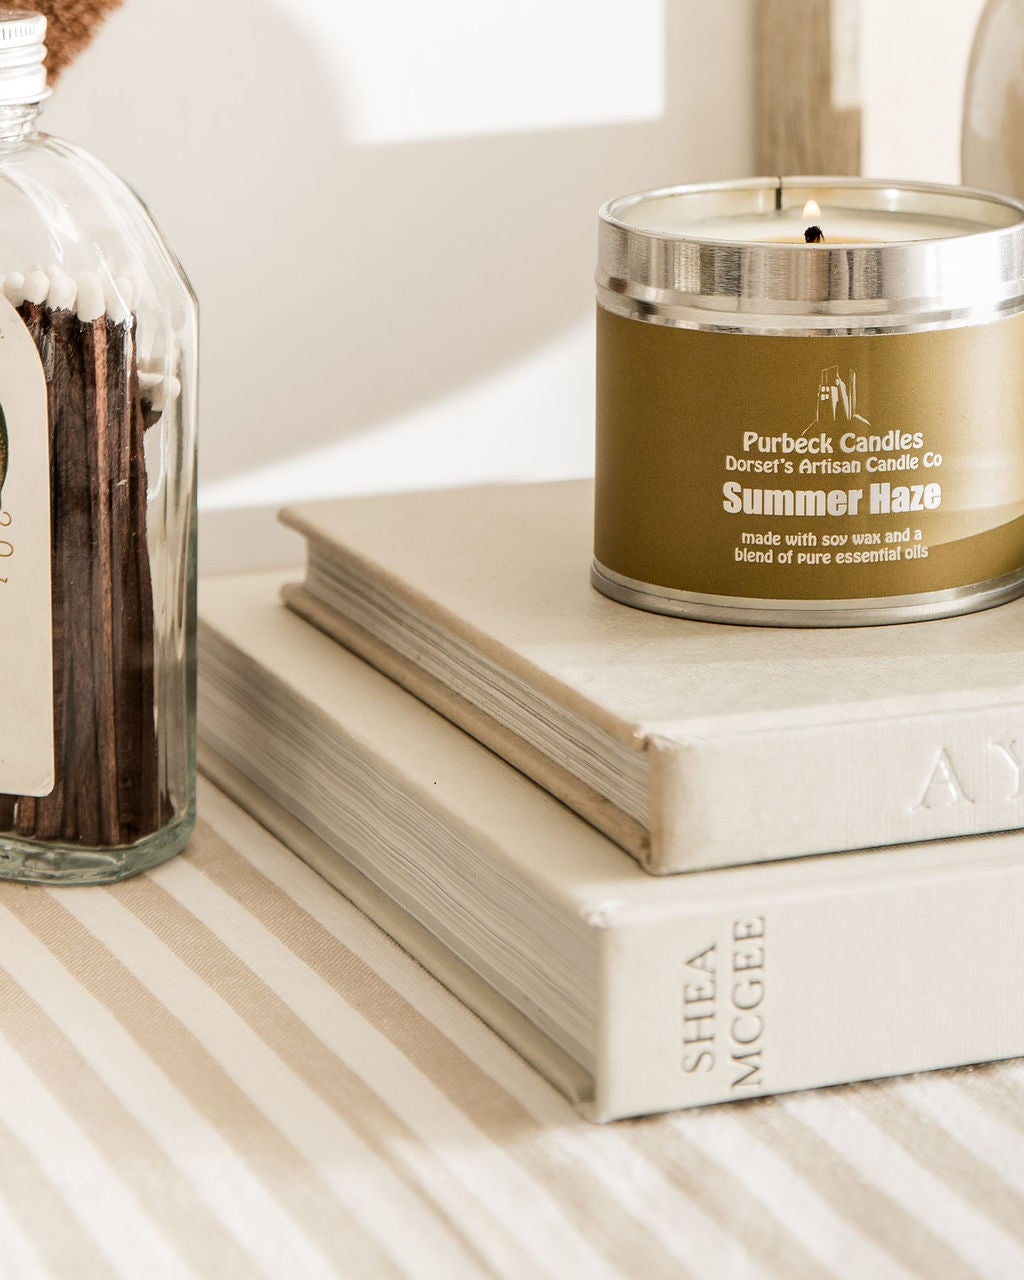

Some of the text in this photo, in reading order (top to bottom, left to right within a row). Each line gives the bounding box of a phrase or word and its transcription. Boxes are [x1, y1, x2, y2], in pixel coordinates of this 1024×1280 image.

[743, 429, 924, 454] Purbeck Candles
[725, 451, 943, 474] Dorset's Artisan Candle Co
[722, 481, 942, 517] Summer Haze
[741, 527, 923, 547] made with soy wax and a
[734, 544, 929, 565] blend of pure essential oils
[909, 747, 975, 811] A
[682, 942, 718, 1073] SHEA
[731, 917, 766, 1090] MCGEE
